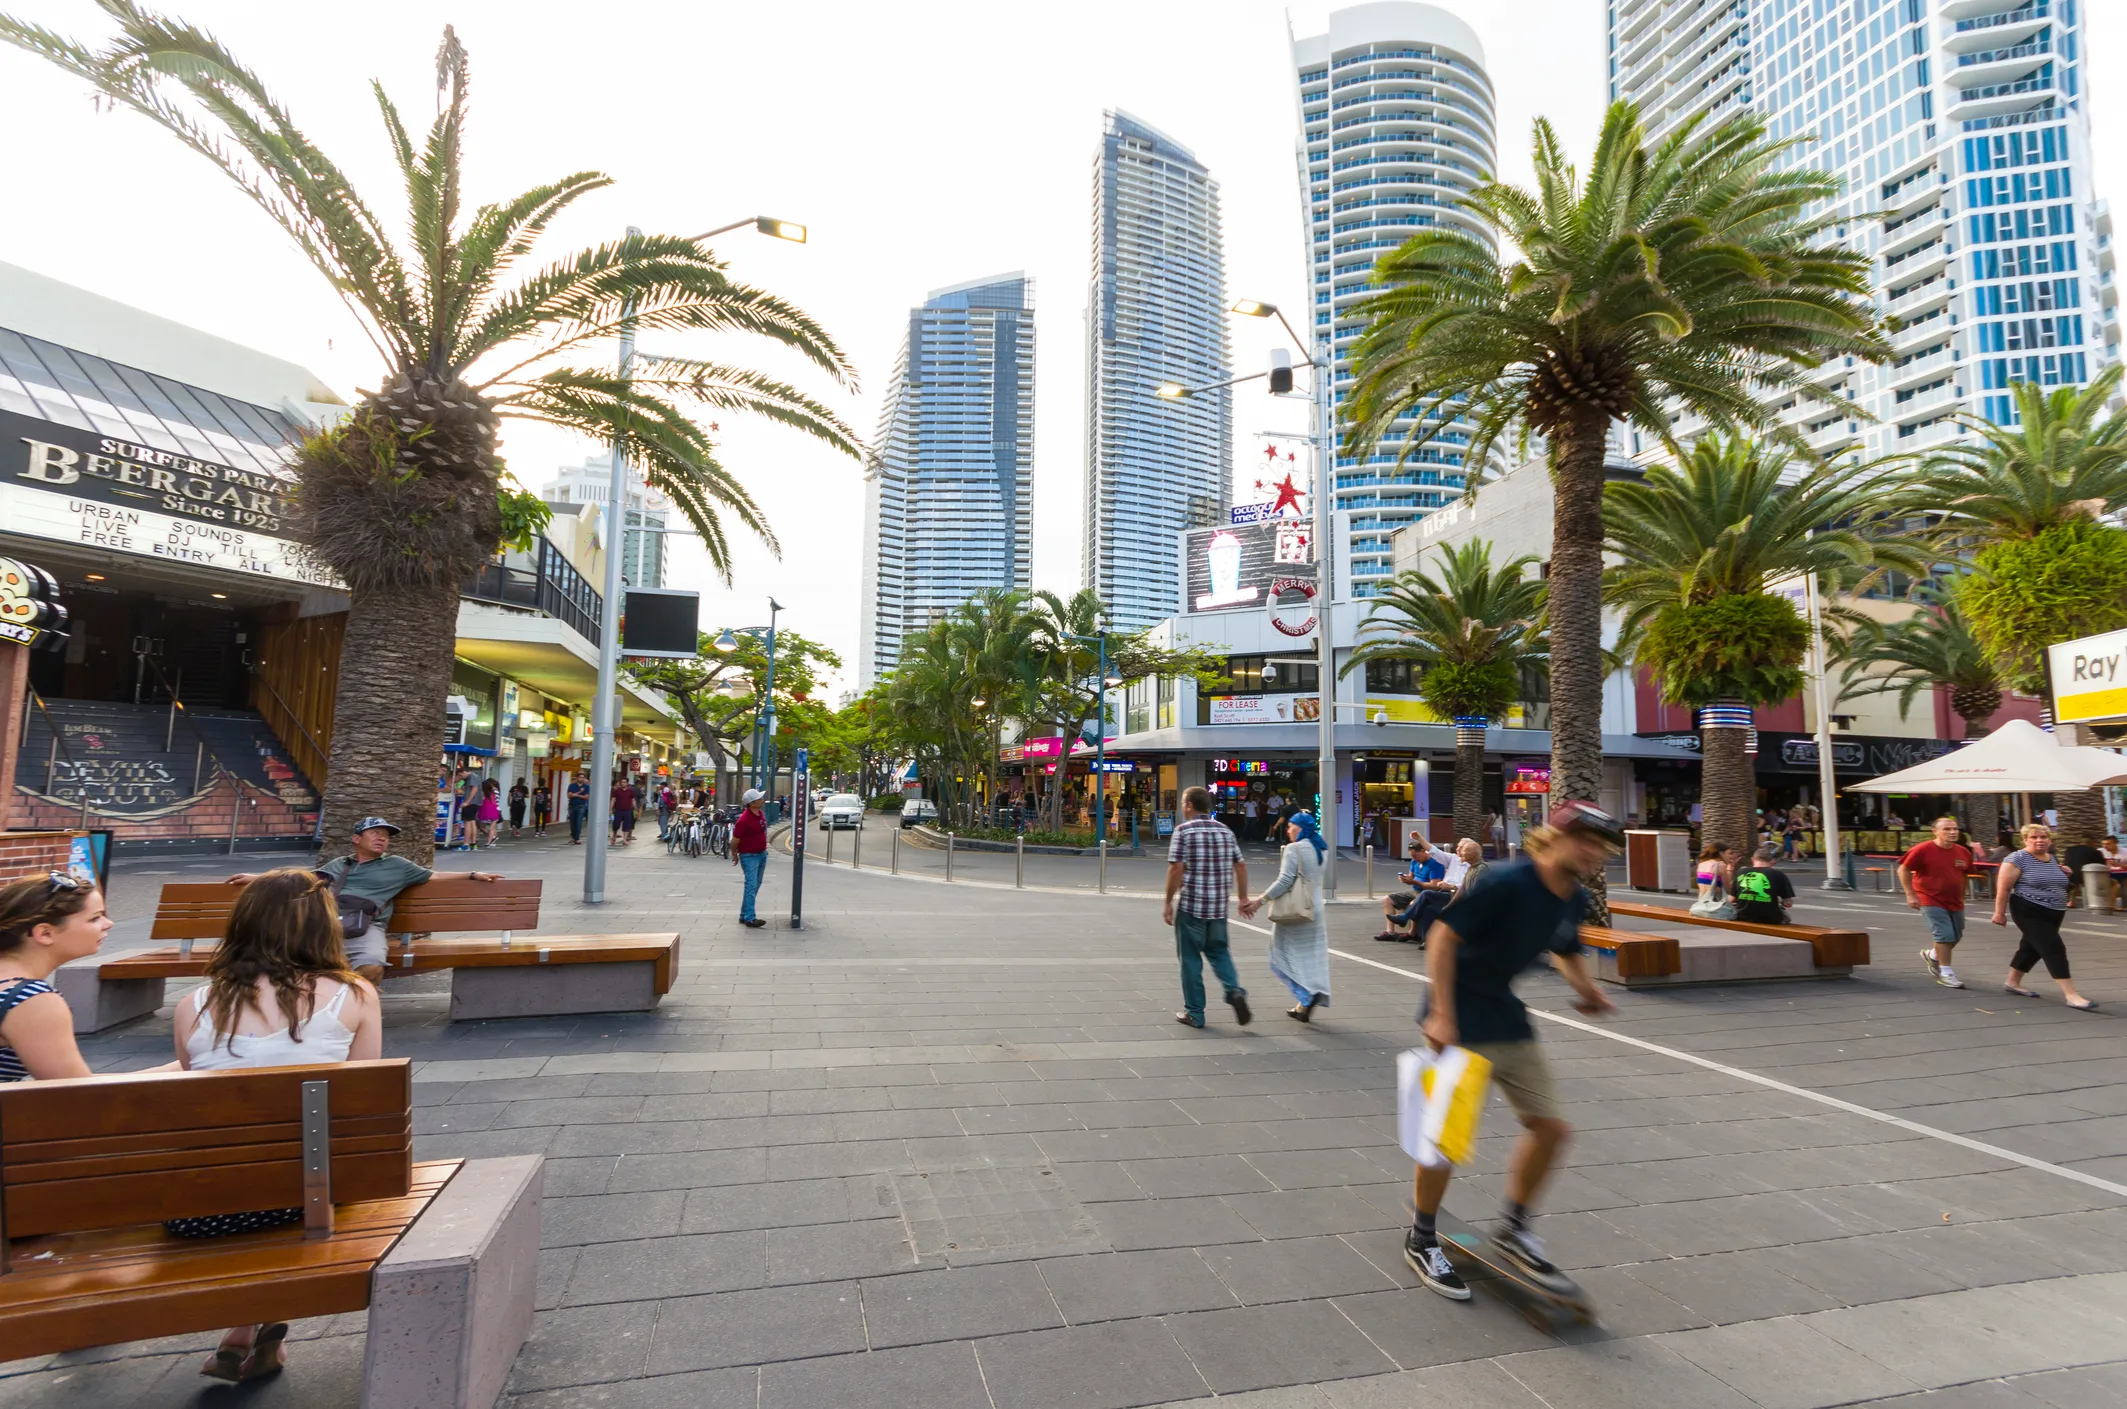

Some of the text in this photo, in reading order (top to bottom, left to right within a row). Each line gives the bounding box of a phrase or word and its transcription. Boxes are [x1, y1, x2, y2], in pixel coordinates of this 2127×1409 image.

[99, 438, 293, 493] SURFERS PARA
[161, 495, 280, 532] Since 1925
[1233, 502, 1279, 516] octopu
[1233, 511, 1271, 523] meda
[69, 501, 139, 525] URBAN
[172, 521, 244, 545] SOUNDS
[81, 517, 127, 536] LIVE
[168, 533, 191, 547] DJ
[221, 543, 259, 559] TILL
[80, 531, 133, 549] FREE
[153, 543, 216, 563] ENTRY
[239, 560, 272, 574] ALL
[1277, 579, 1311, 594] MERRY
[1276, 617, 1318, 635] CHRISTMAS
[2073, 654, 2120, 682] Ray
[1235, 700, 1258, 708] LEASE
[1229, 759, 1268, 772] Cinema
